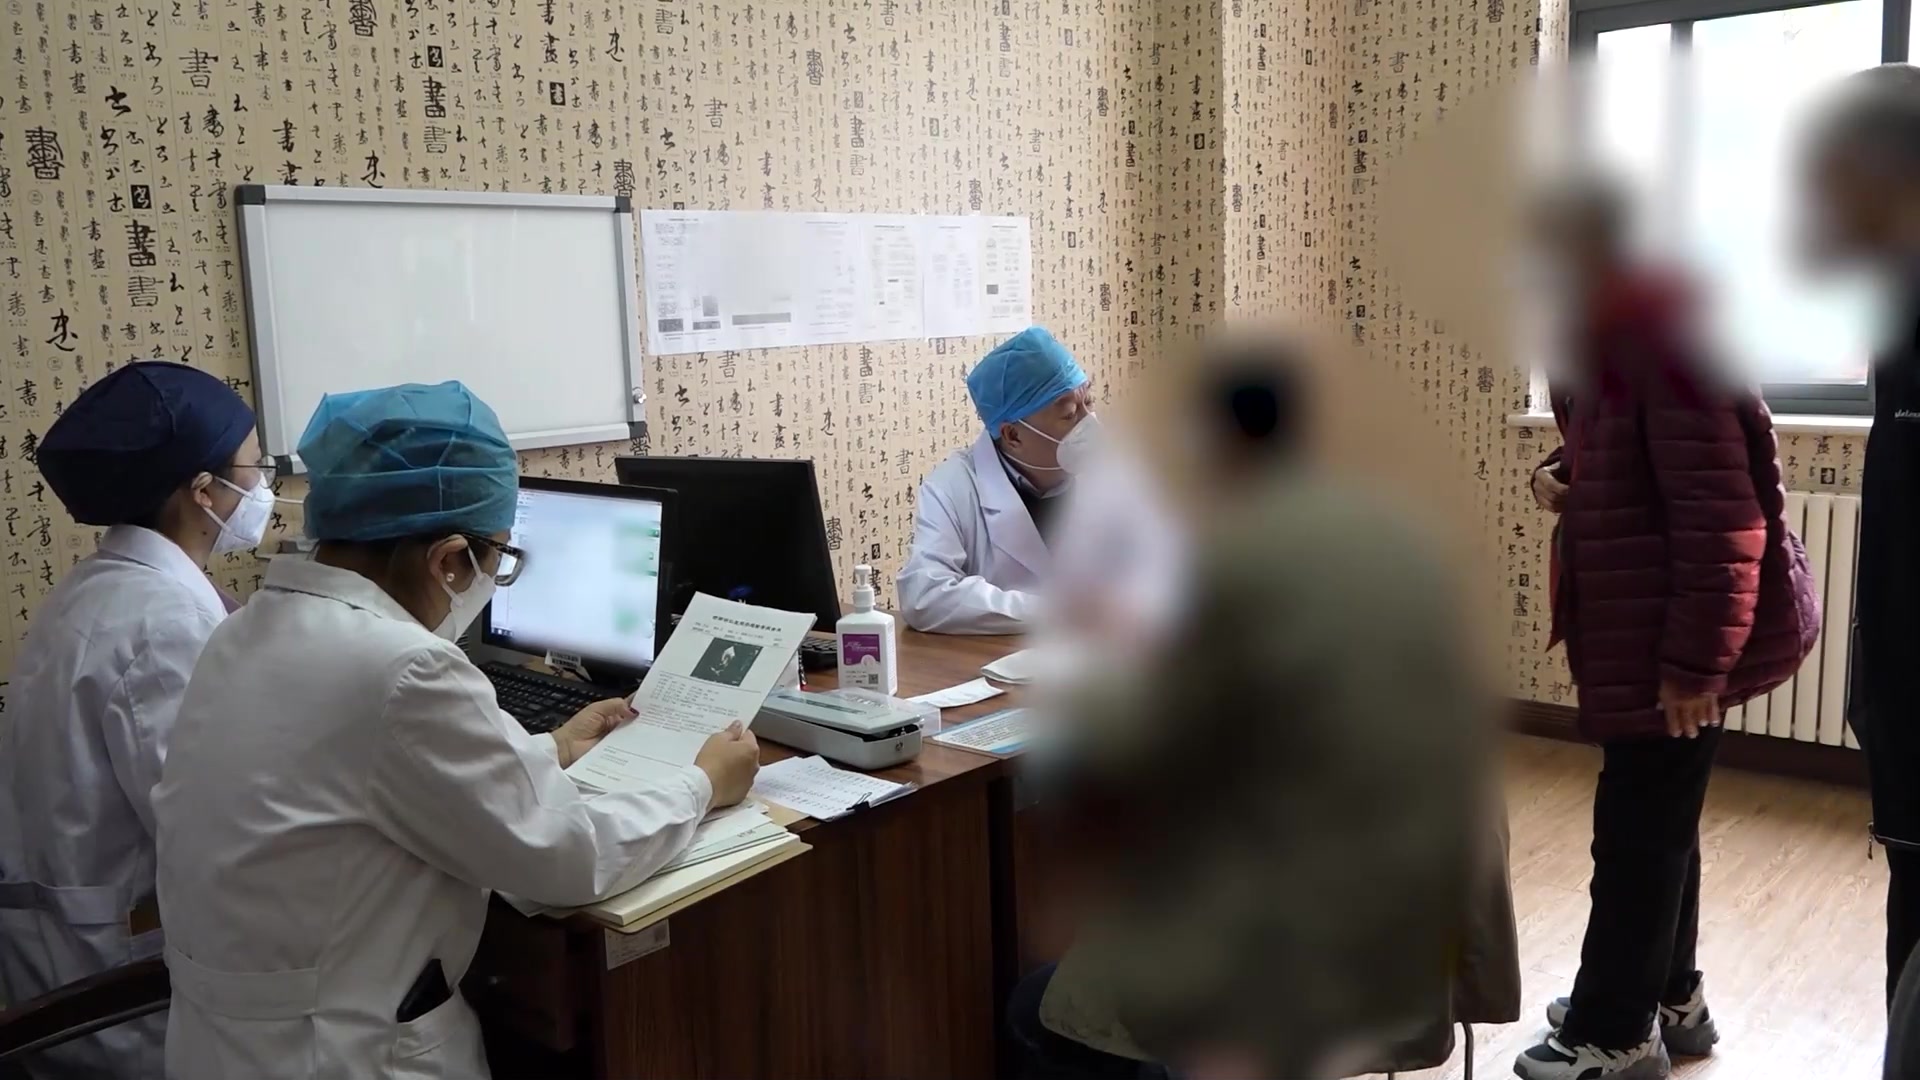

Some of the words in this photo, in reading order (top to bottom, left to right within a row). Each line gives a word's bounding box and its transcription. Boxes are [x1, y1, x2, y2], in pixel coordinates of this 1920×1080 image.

[879, 0, 898, 27] 書
[179, 48, 219, 89] 書
[704, 97, 728, 129] 書
[1028, 128, 1045, 152] 書
[717, 350, 741, 379] 書
[895, 448, 915, 475] 書
